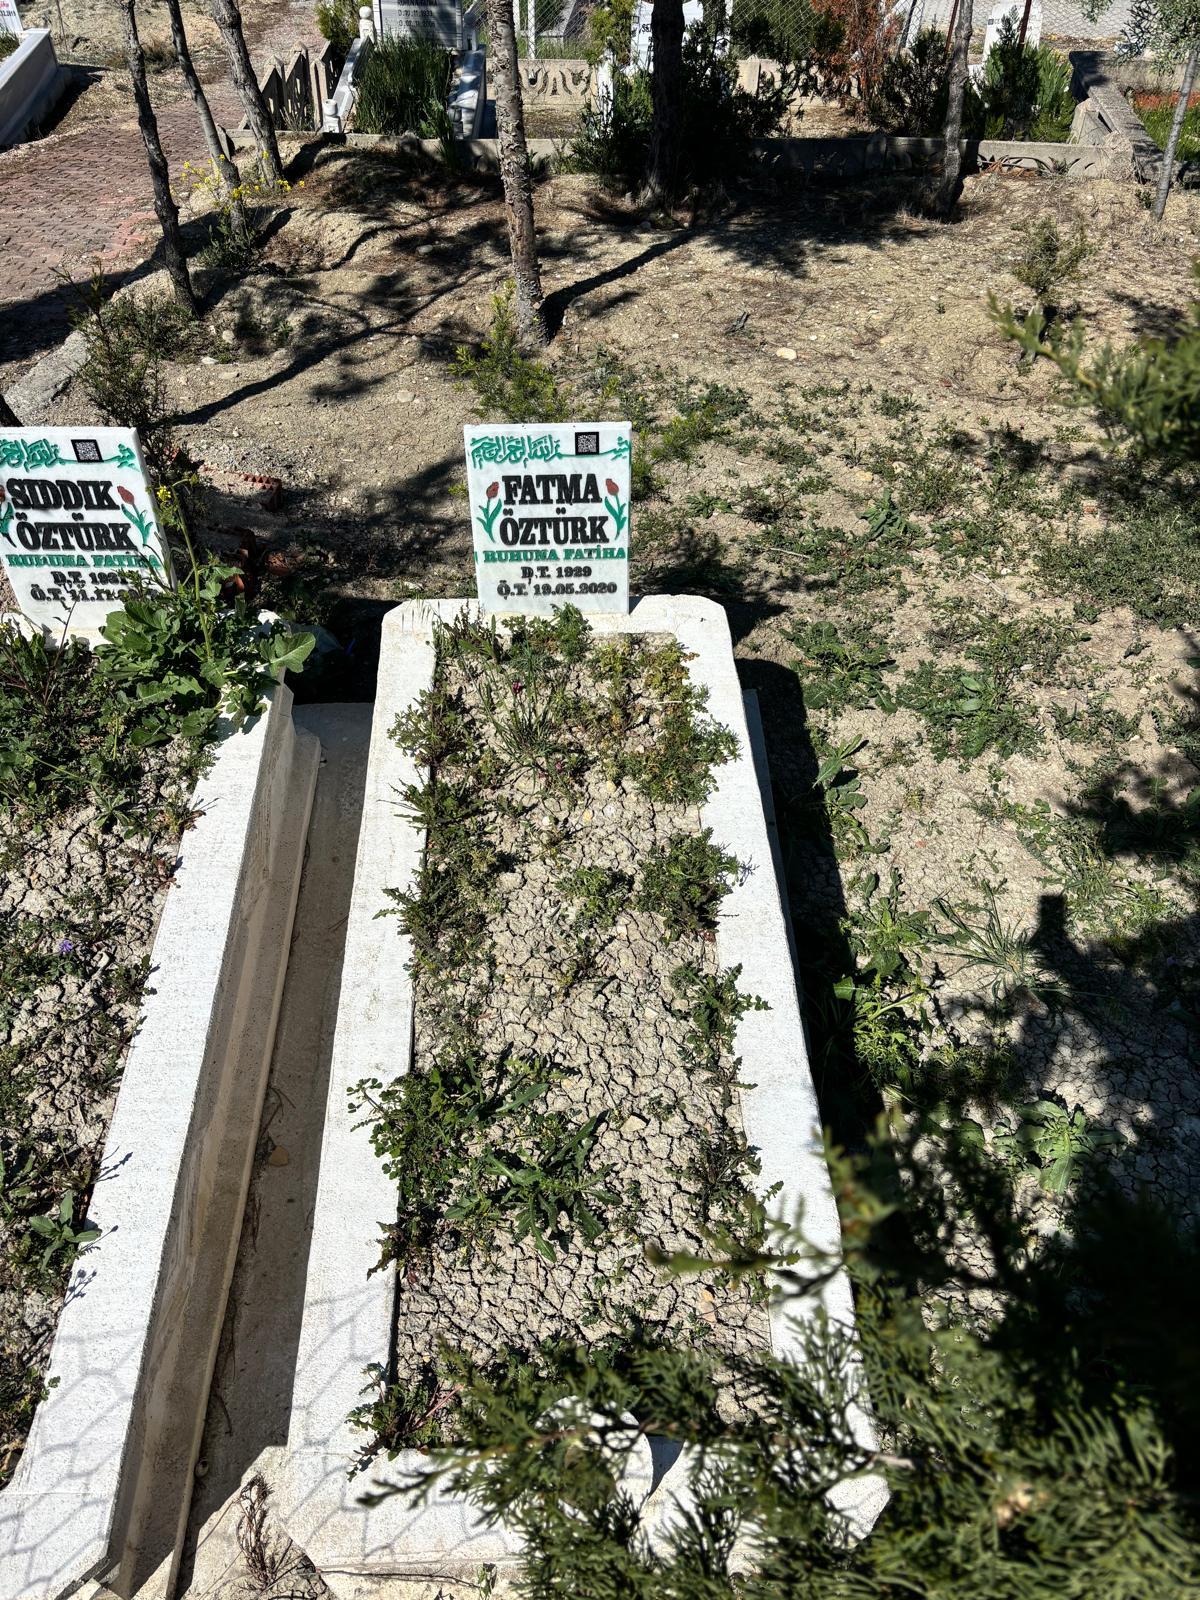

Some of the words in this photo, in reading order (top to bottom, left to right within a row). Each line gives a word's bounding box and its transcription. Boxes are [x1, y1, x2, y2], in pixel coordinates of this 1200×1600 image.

[6, 478, 120, 510] SIDDIK
[502, 473, 602, 506] FATMA
[15, 512, 138, 551] ÖZTÜRK
[499, 507, 609, 546] ÖZTÜRK
[483, 549, 560, 563] RUHUNA
[497, 580, 528, 596] Ö.T.
[521, 566, 550, 579] D.T.
